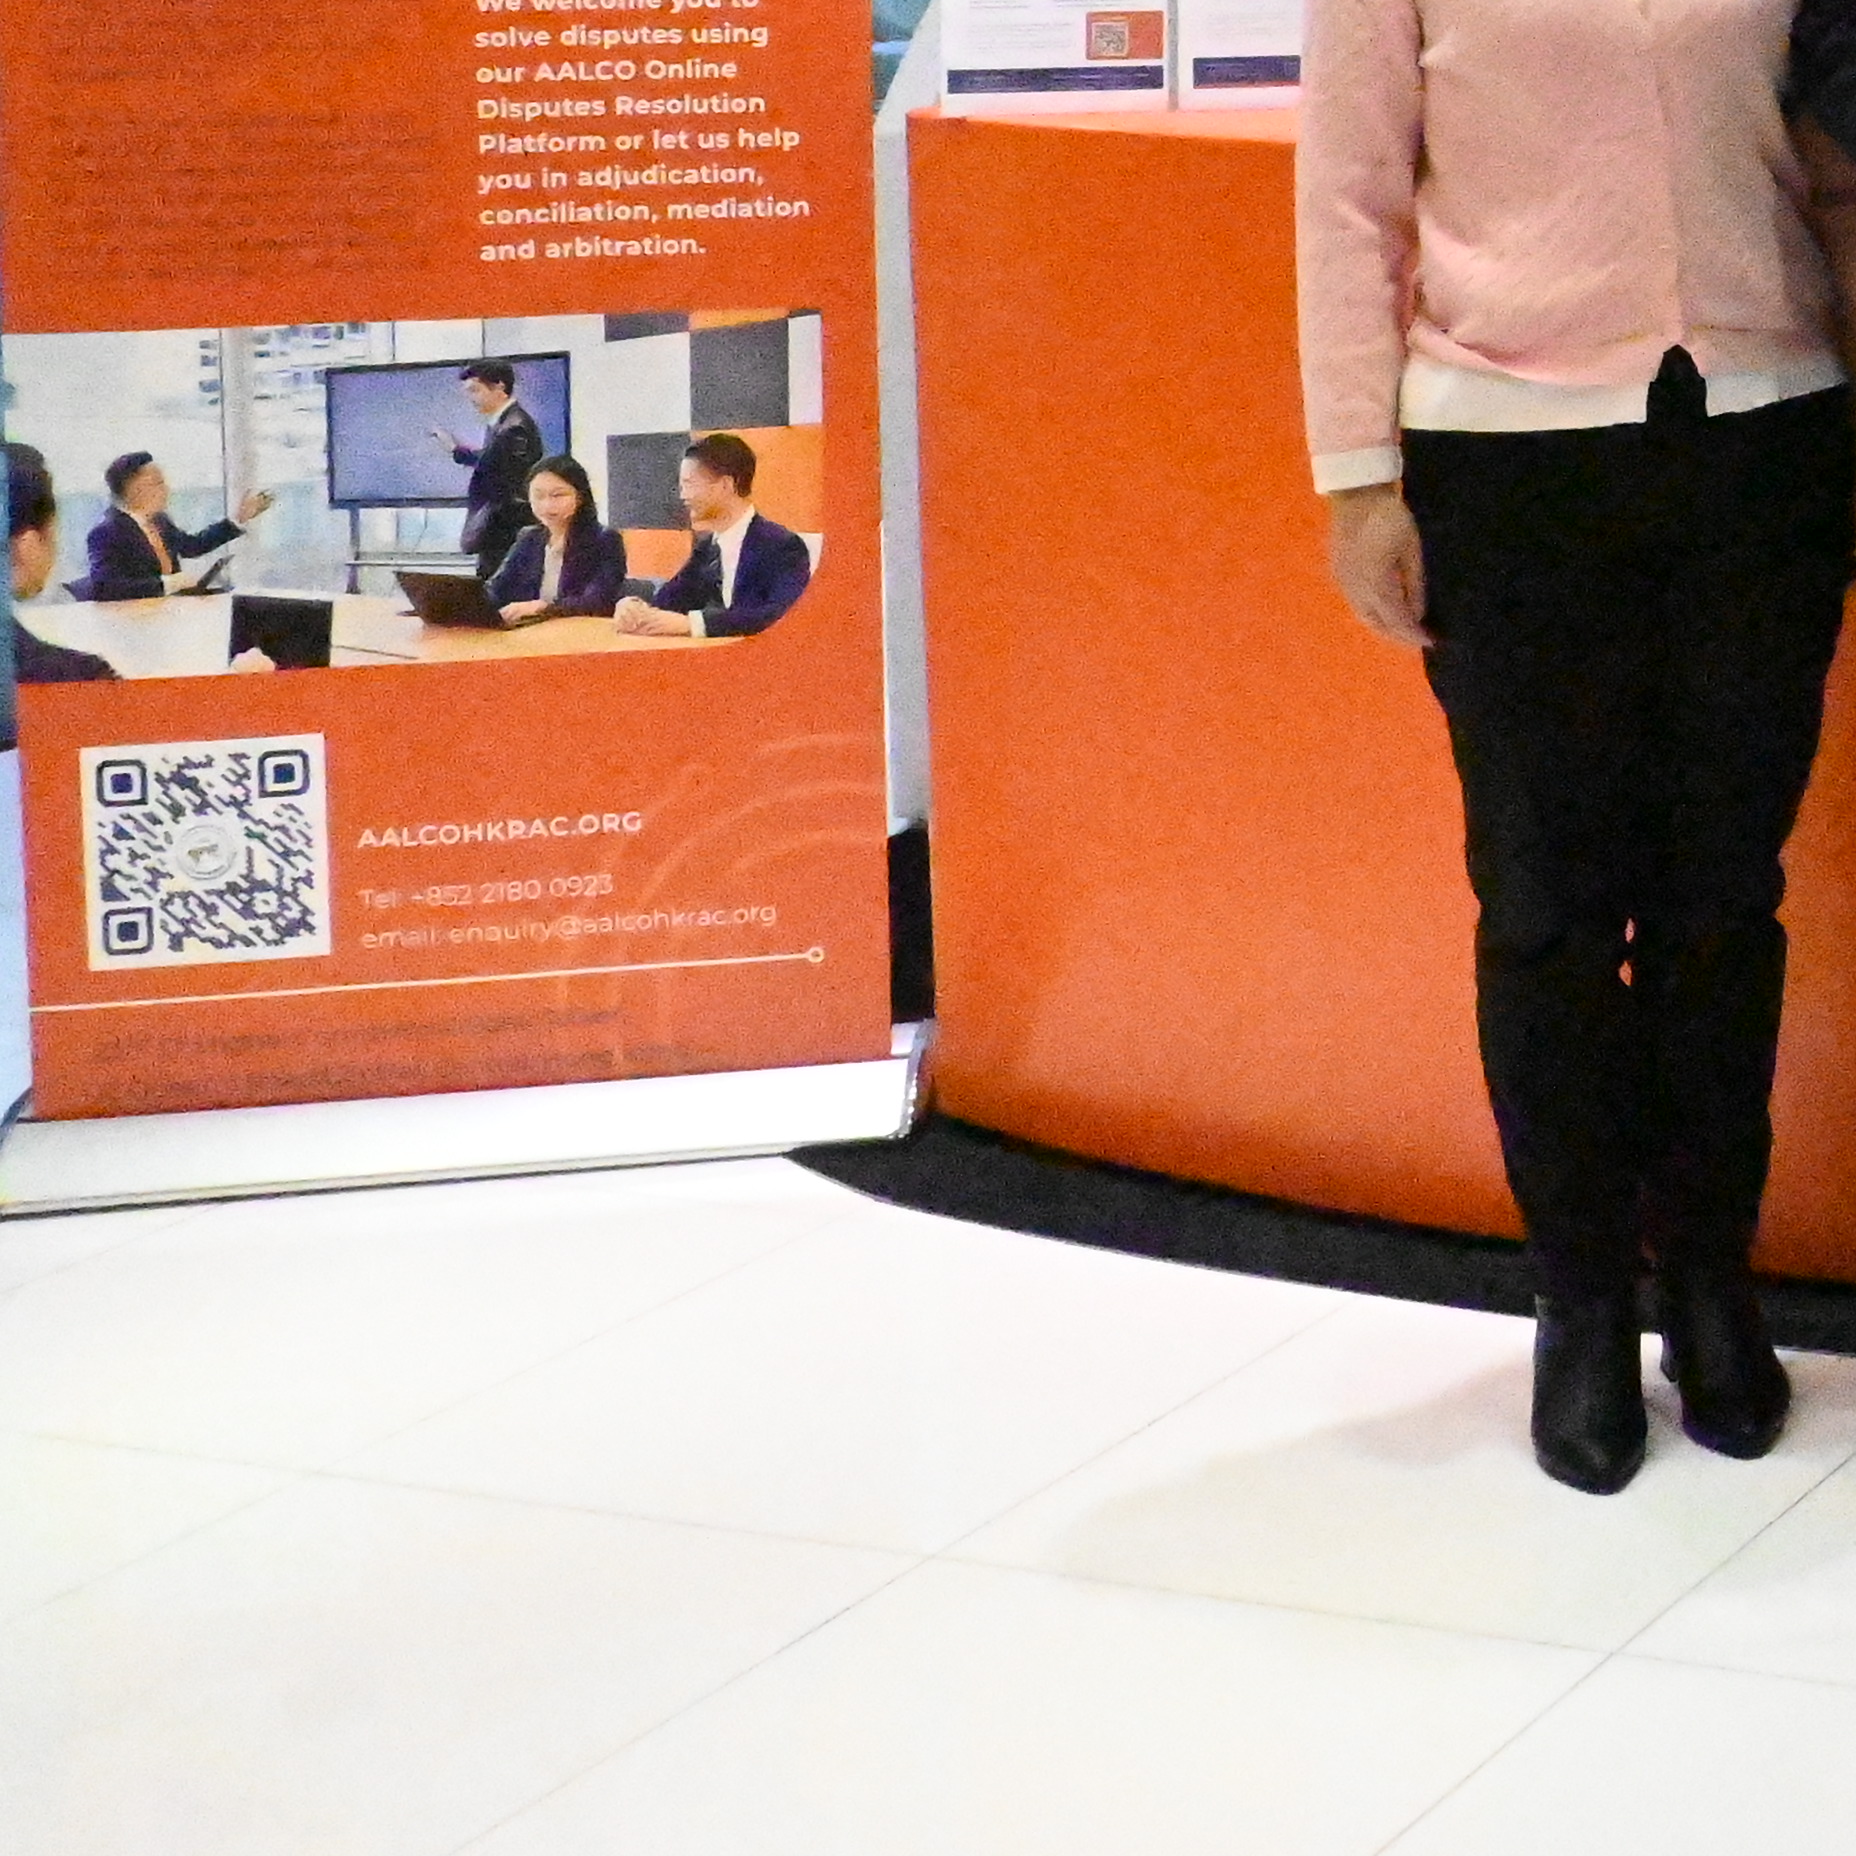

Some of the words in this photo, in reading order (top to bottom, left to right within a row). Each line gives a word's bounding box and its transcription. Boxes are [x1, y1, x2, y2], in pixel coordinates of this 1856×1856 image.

[475, 26, 551, 48] solve
[560, 24, 683, 49] disputes
[691, 22, 769, 48] using
[476, 66, 524, 83] our
[534, 60, 636, 81] AALCO
[645, 58, 738, 81] Online
[477, 97, 606, 122] Disputes
[615, 93, 766, 116] Resolution
[478, 133, 605, 154] Platform
[615, 132, 644, 150] or
[653, 129, 690, 150] let
[698, 131, 730, 149] us
[738, 128, 800, 151] help
[478, 174, 531, 194] you
[542, 167, 567, 187] in
[577, 163, 764, 189] adjudication,
[479, 201, 660, 225] conciliation,
[667, 196, 810, 220] mediation
[479, 240, 535, 261] and
[546, 234, 707, 259] arbitration.
[357, 811, 643, 849] AALCOHKRAC.ORG
[481, 879, 541, 905] 2180
[549, 874, 614, 898] 0923
